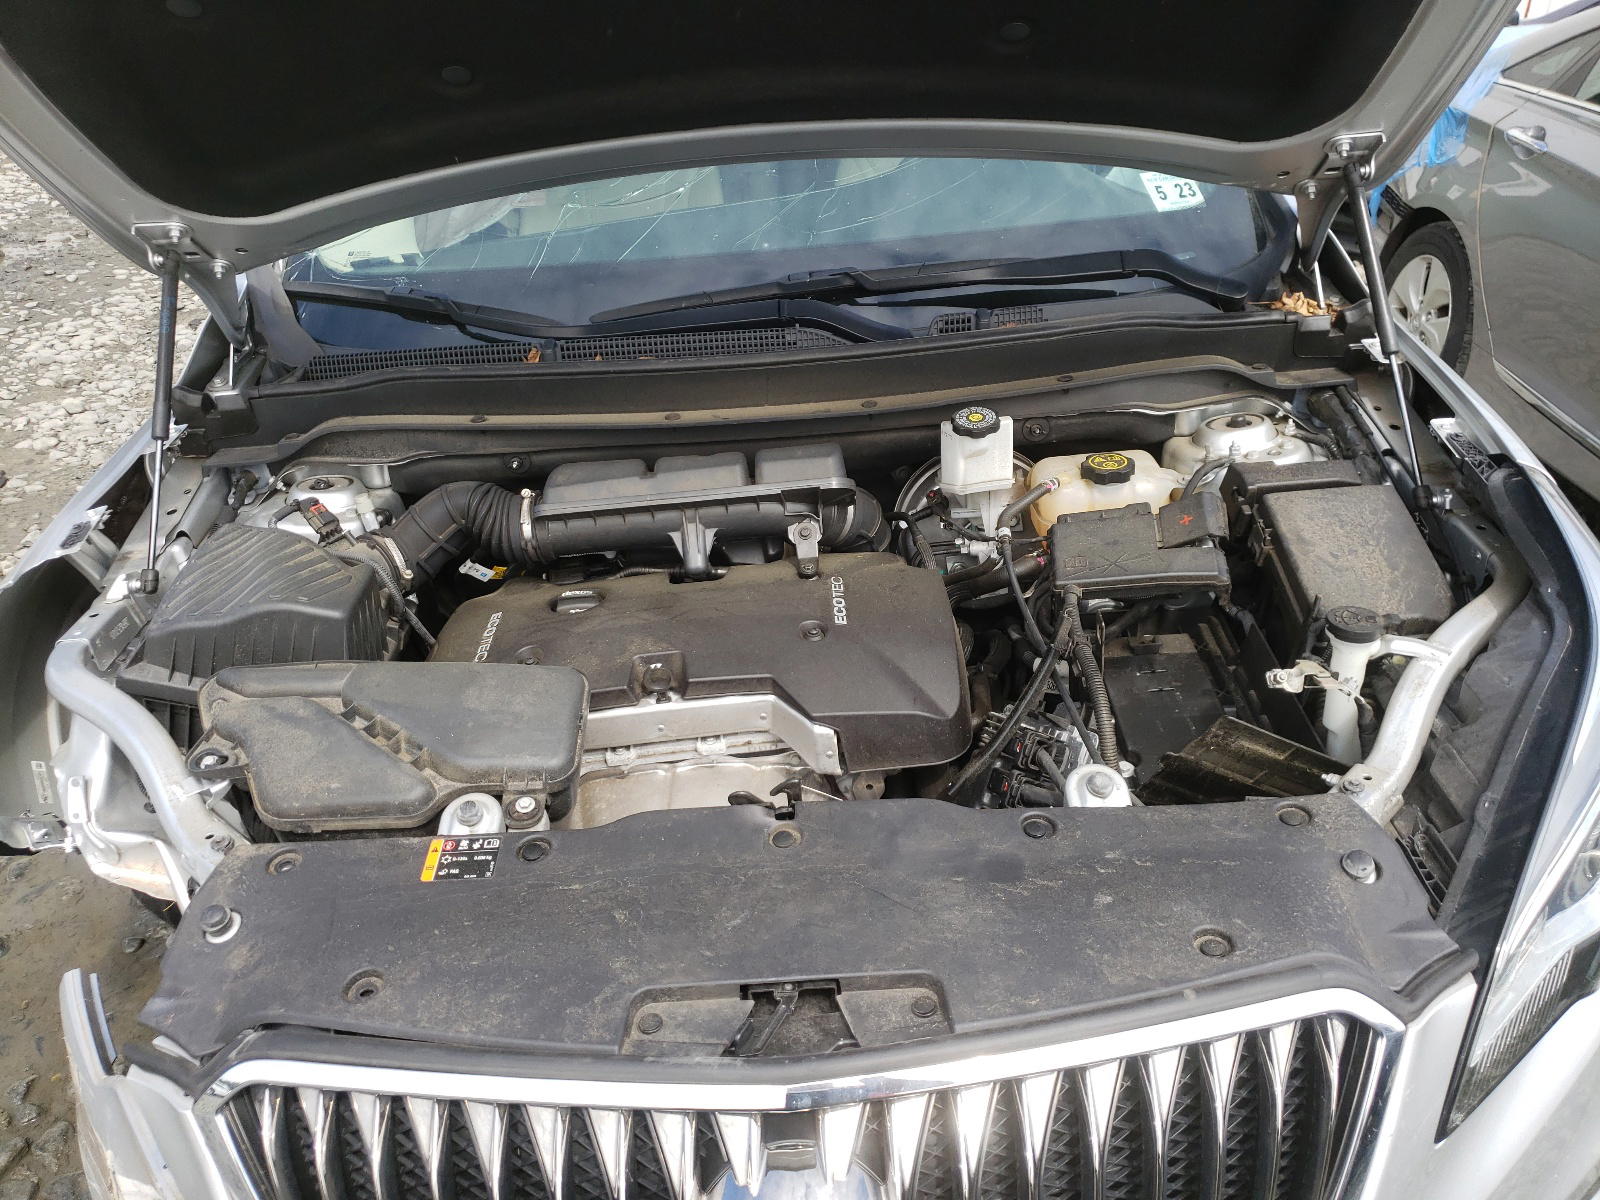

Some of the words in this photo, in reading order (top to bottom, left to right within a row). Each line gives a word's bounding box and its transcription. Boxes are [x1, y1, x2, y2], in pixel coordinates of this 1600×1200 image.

[1154, 185, 1168, 201] 5
[1174, 181, 1197, 199] 23
[831, 576, 848, 625] ECOTEC
[474, 611, 503, 662] ECOTEC
